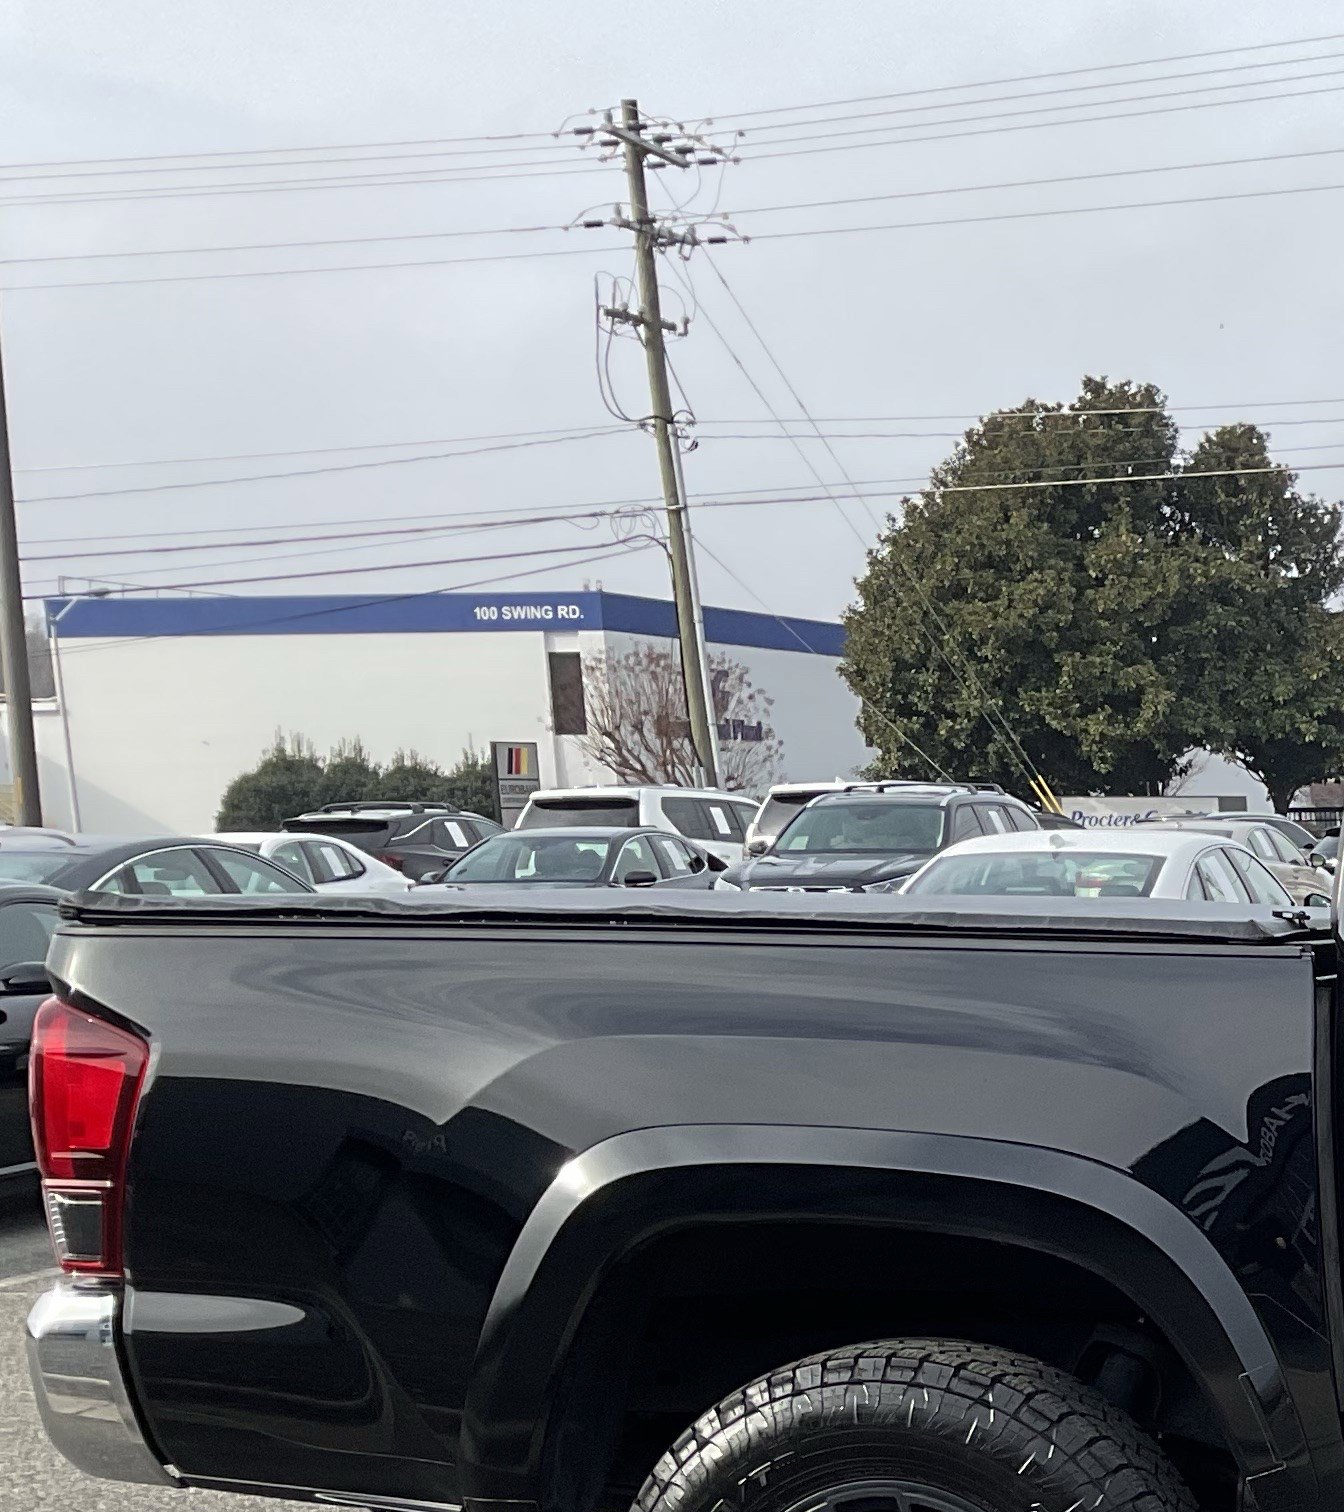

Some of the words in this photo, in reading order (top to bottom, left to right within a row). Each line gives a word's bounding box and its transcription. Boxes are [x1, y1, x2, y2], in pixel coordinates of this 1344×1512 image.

[473, 606, 498, 620] 100
[501, 605, 554, 620] SWING
[557, 605, 585, 619] RD.
